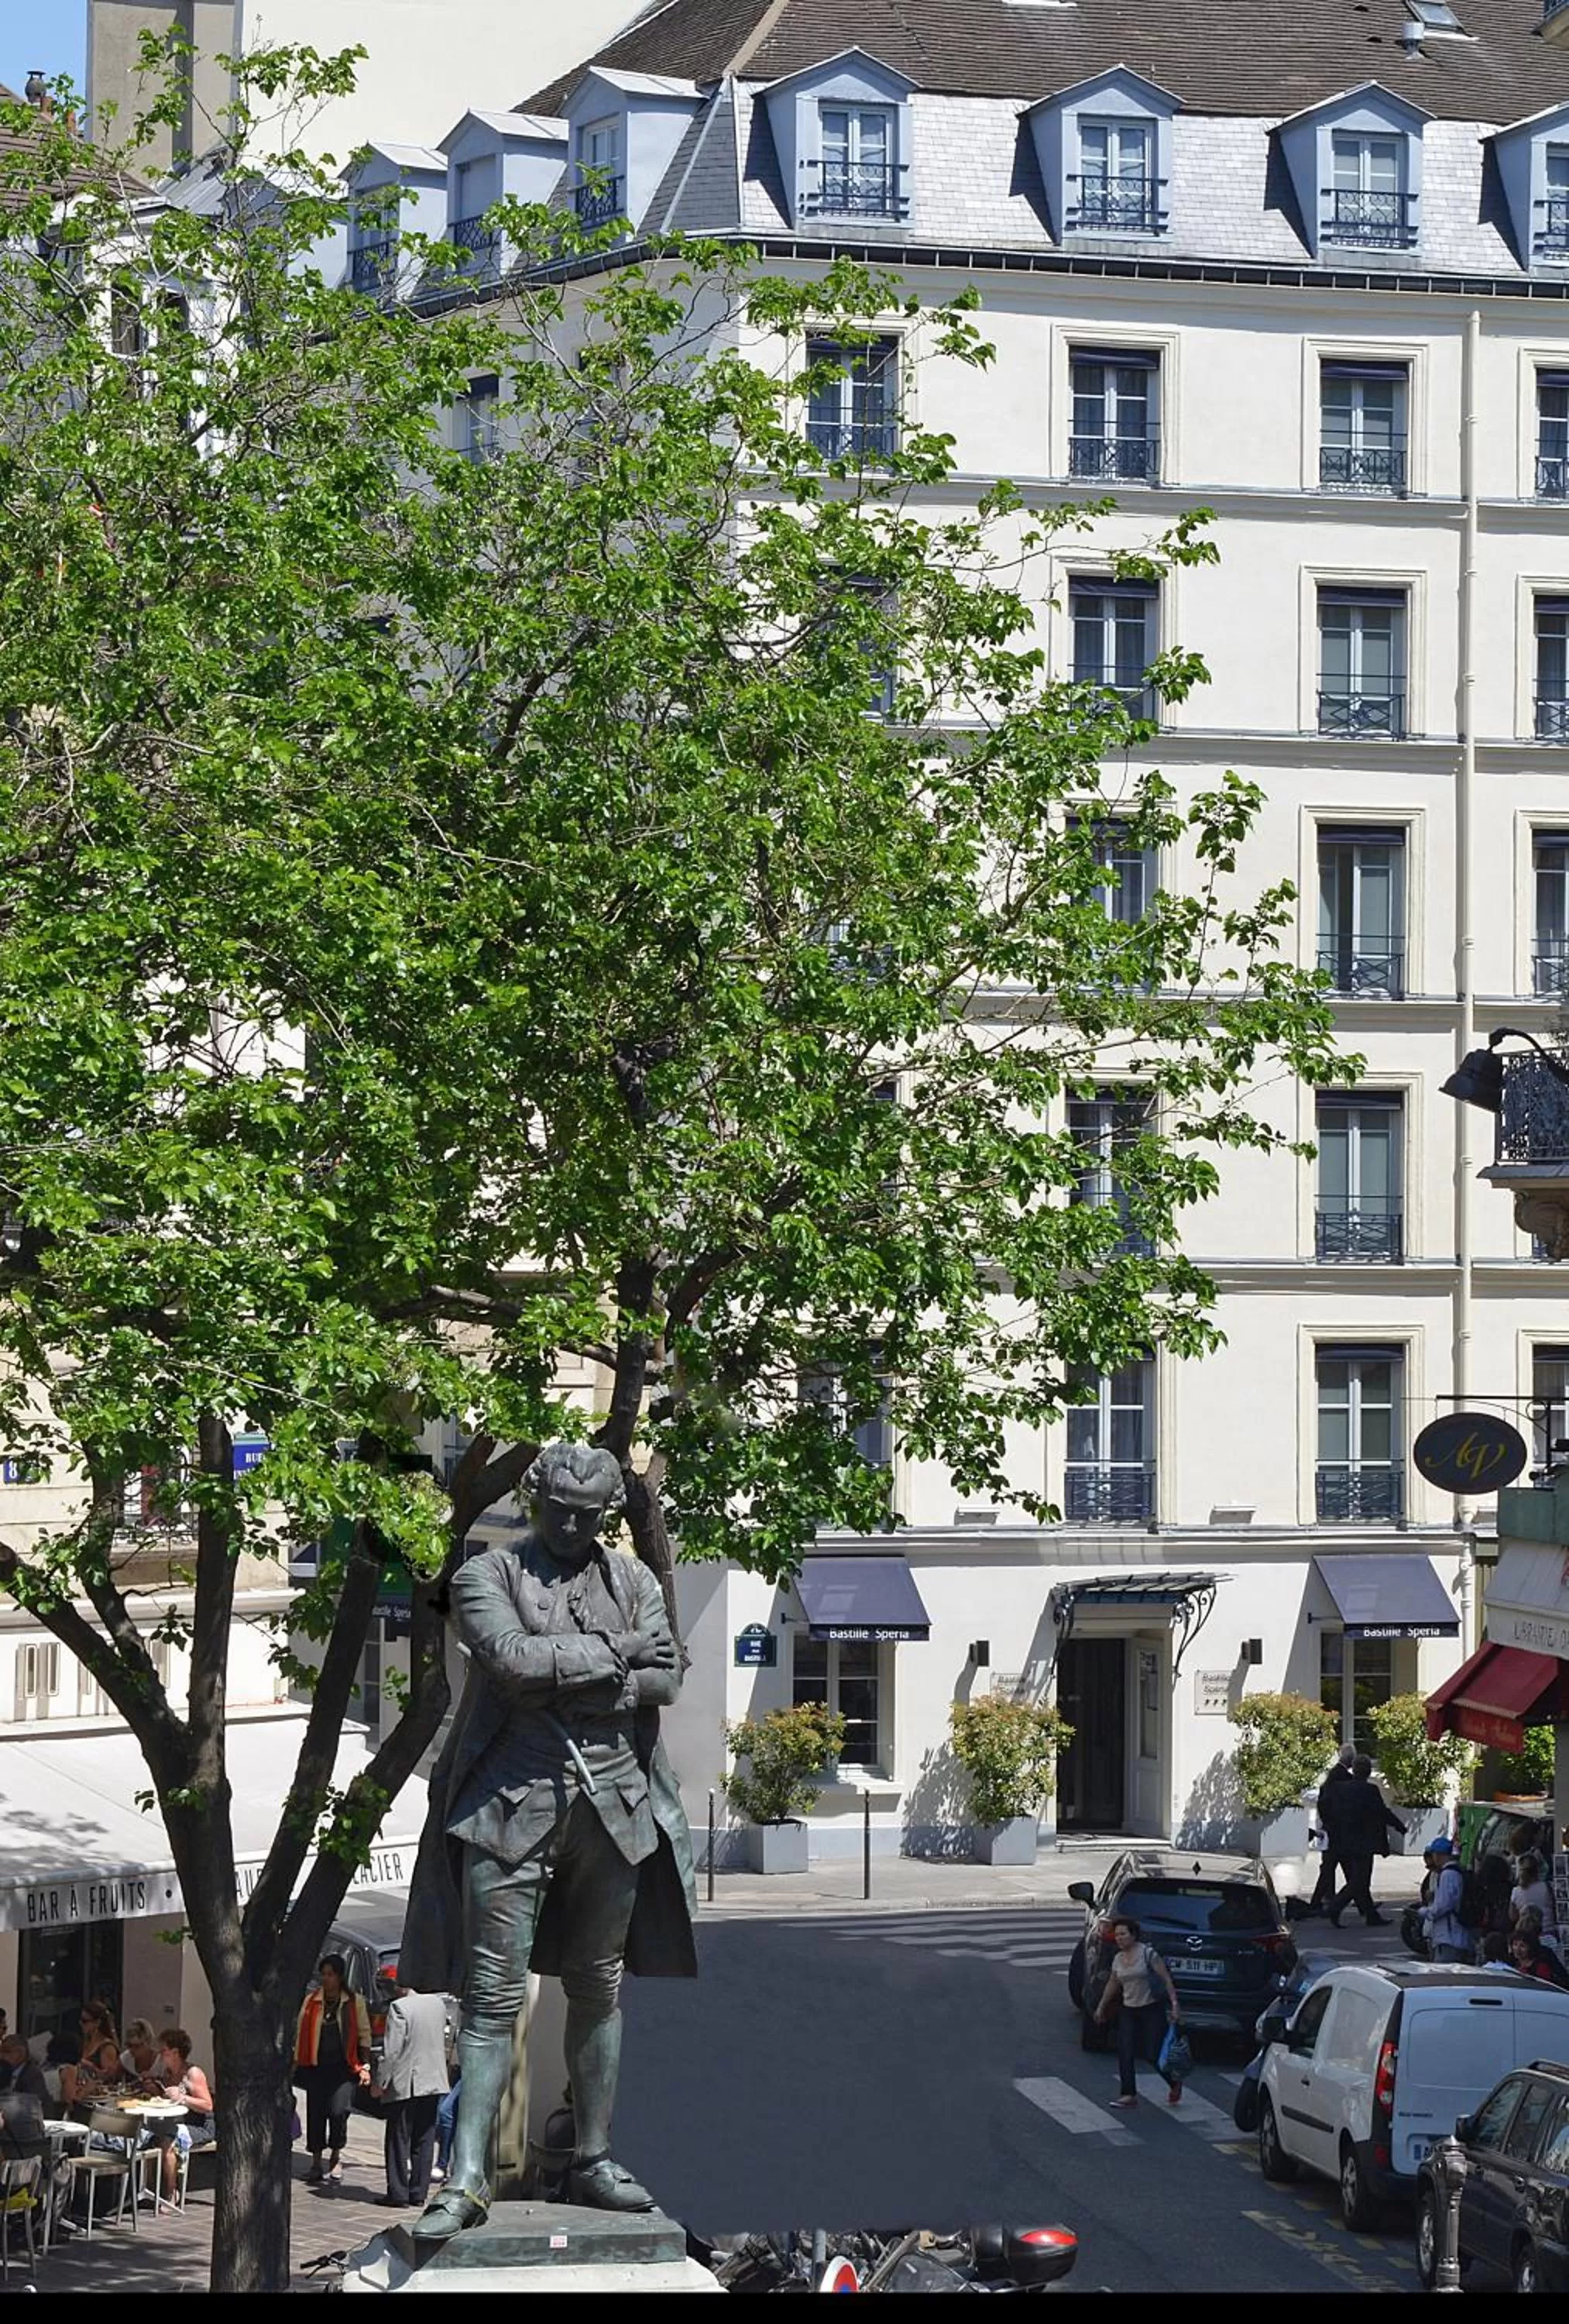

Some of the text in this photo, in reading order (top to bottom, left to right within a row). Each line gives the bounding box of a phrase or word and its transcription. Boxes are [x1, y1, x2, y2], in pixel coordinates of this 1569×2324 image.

[829, 1628, 869, 1638] Bastille
[1363, 1627, 1402, 1637] Bastille
[27, 1882, 146, 1922] BAR À FRUITS
